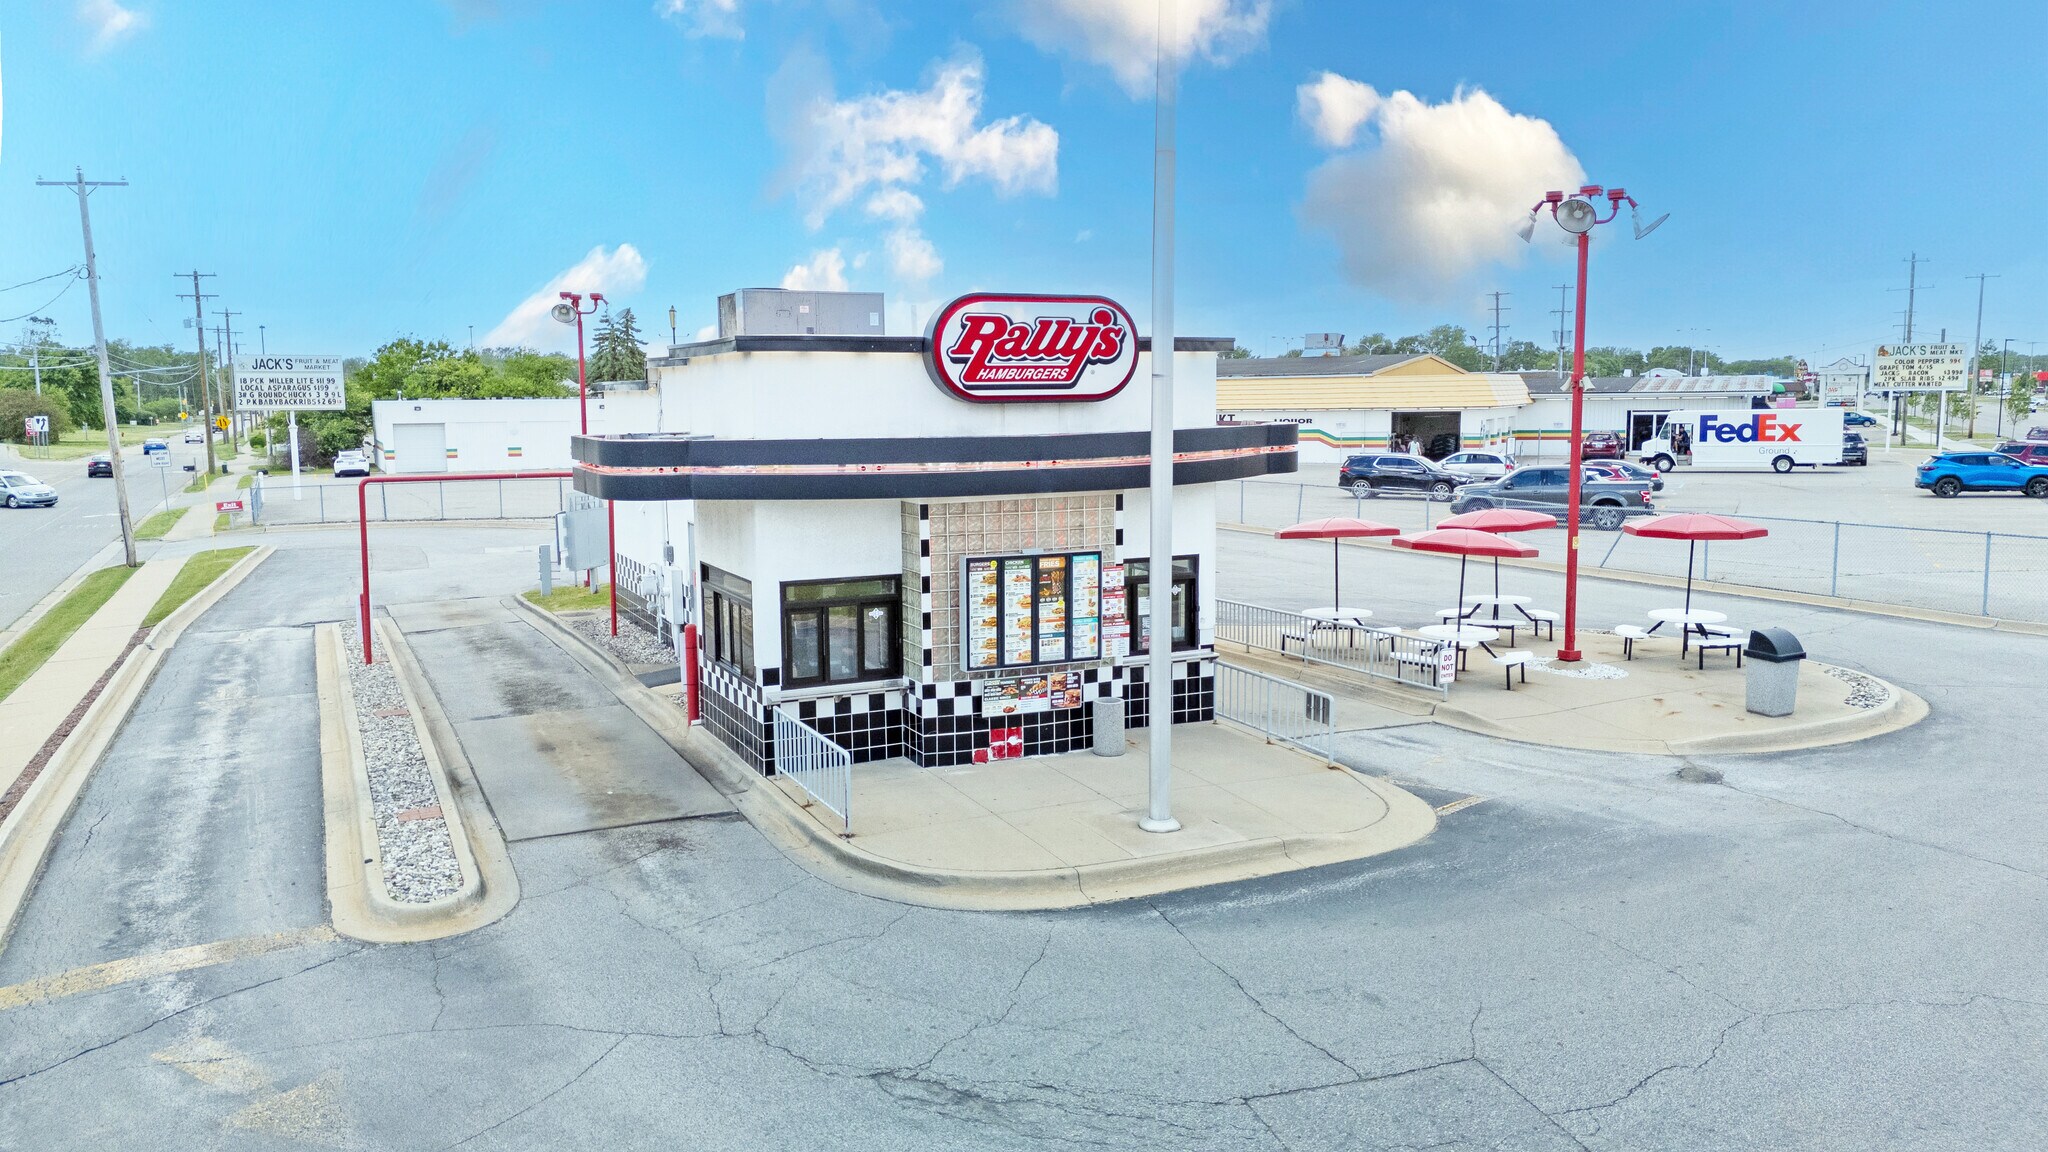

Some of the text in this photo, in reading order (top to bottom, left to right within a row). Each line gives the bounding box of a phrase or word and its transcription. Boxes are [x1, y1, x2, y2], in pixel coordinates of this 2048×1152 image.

[949, 309, 1124, 381] Rally's
[1890, 345, 1927, 356] JACK'S
[252, 358, 294, 370] JACK'S
[975, 367, 1070, 380] HAMBURGERS
[1216, 414, 1236, 422] KT
[1699, 413, 1803, 443] FedEx
[1758, 446, 1790, 455] Ground
[1039, 560, 1060, 568] FRIES
